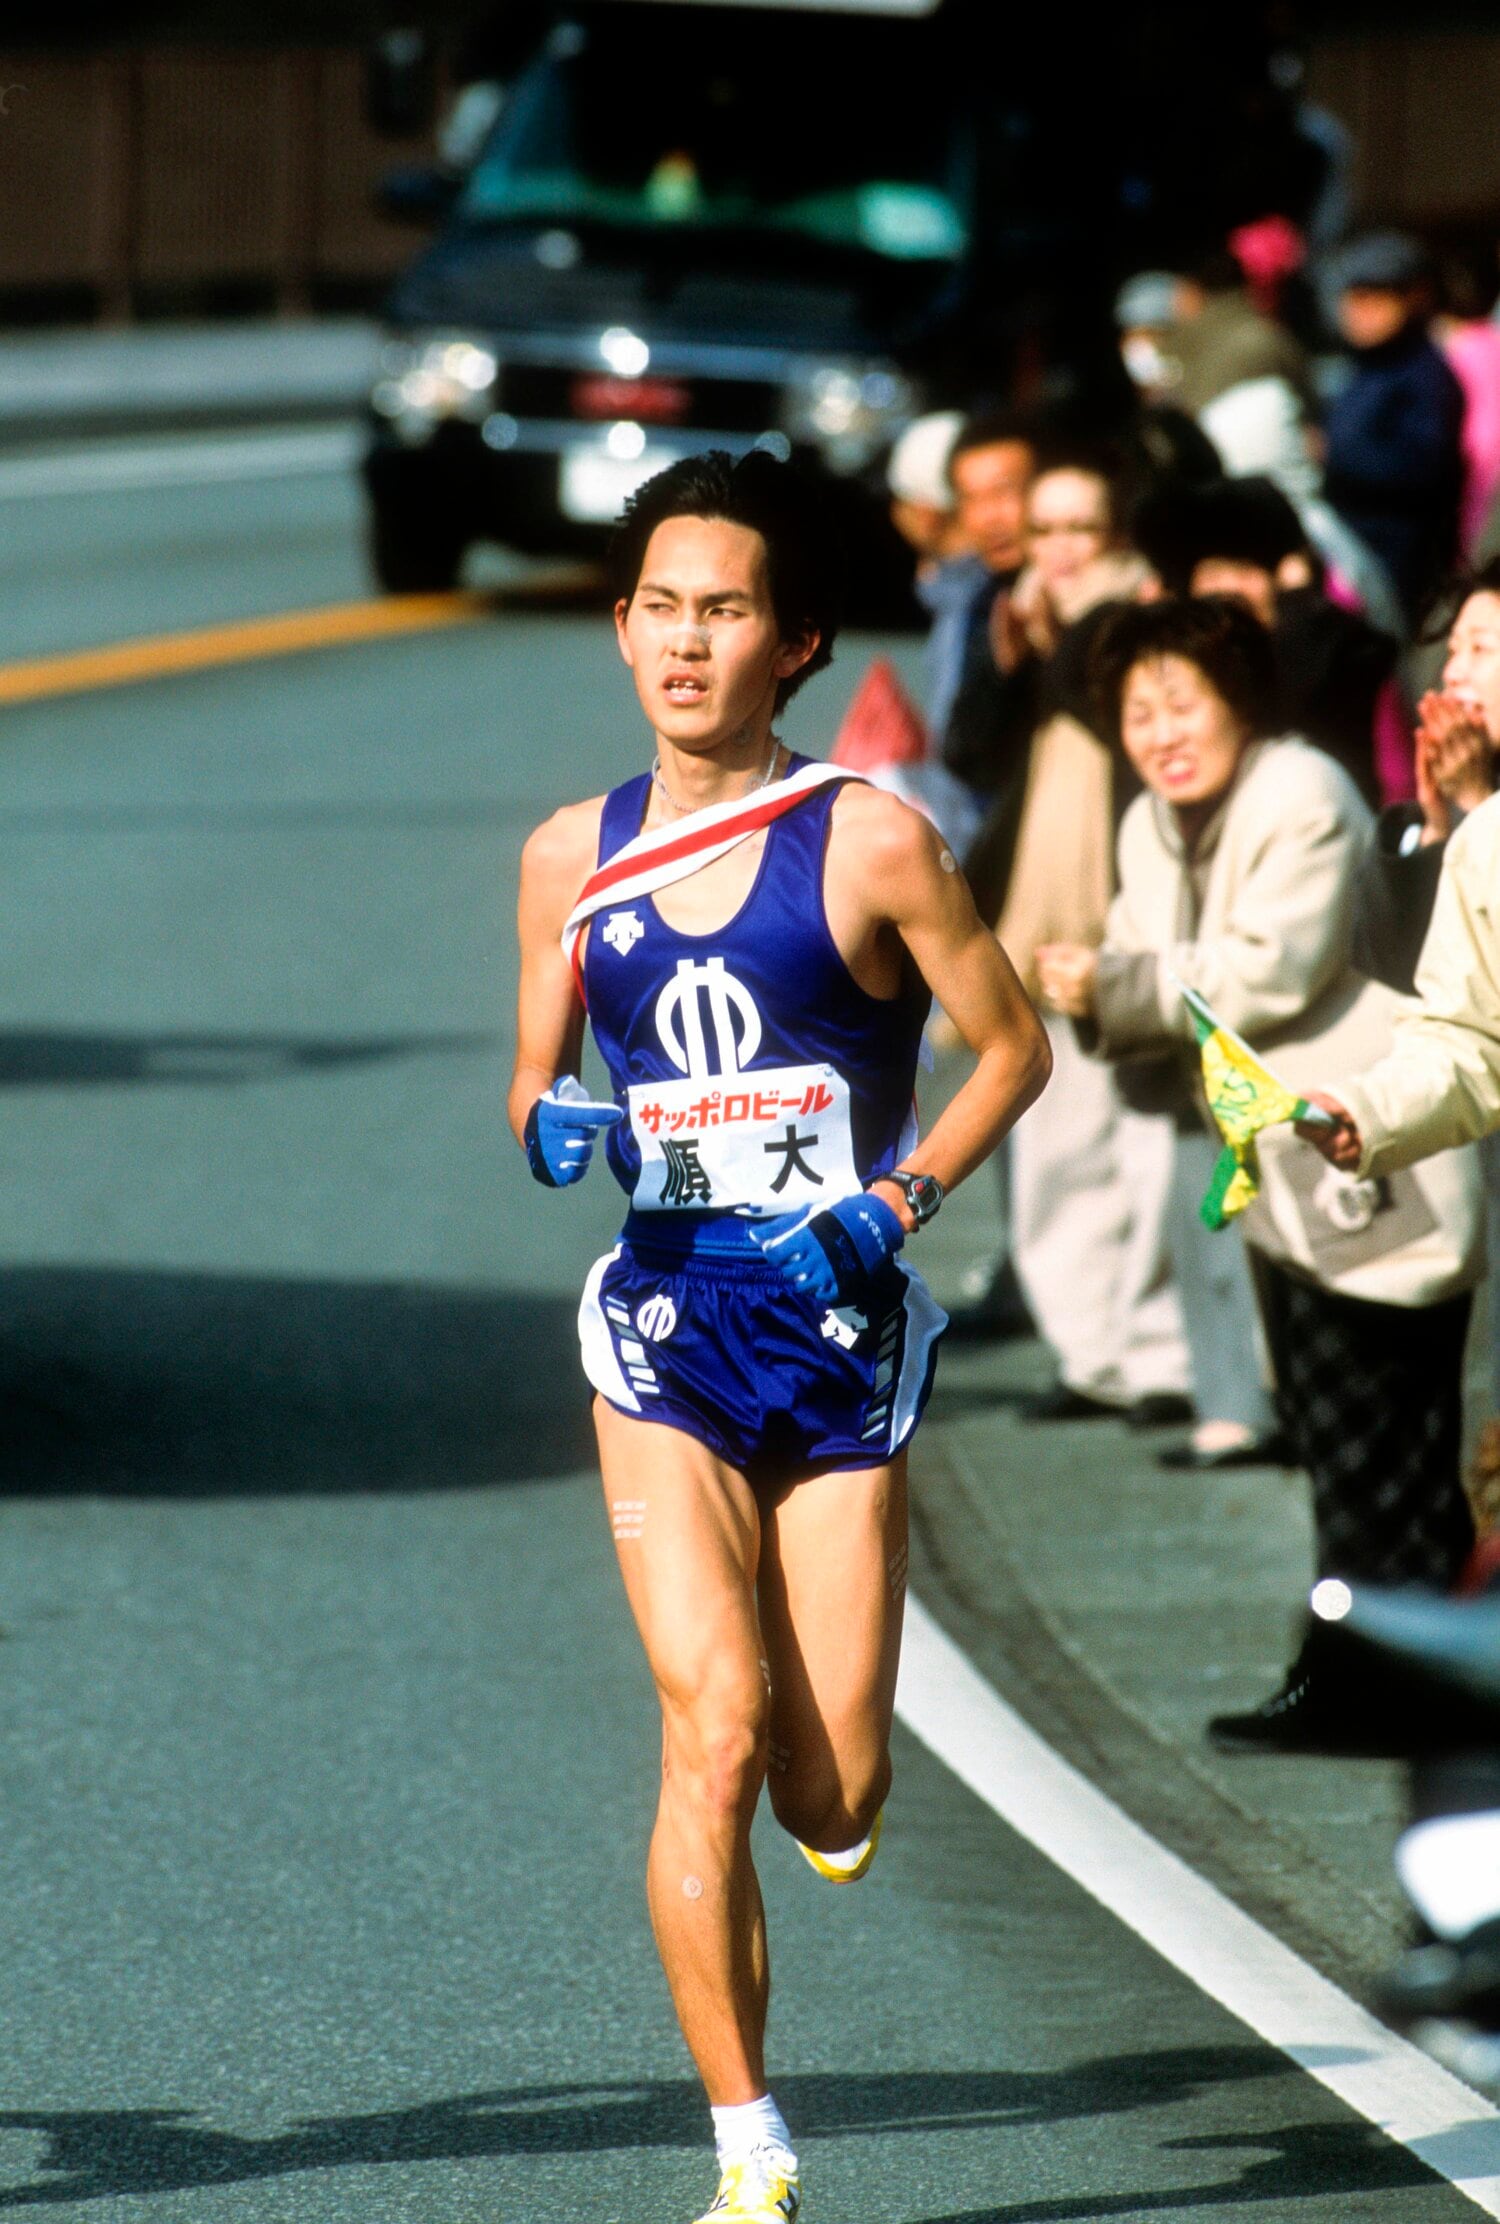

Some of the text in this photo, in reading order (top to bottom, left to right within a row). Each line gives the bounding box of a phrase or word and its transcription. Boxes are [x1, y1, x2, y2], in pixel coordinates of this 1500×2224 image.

[639, 1083, 834, 1134] サッポロビール
